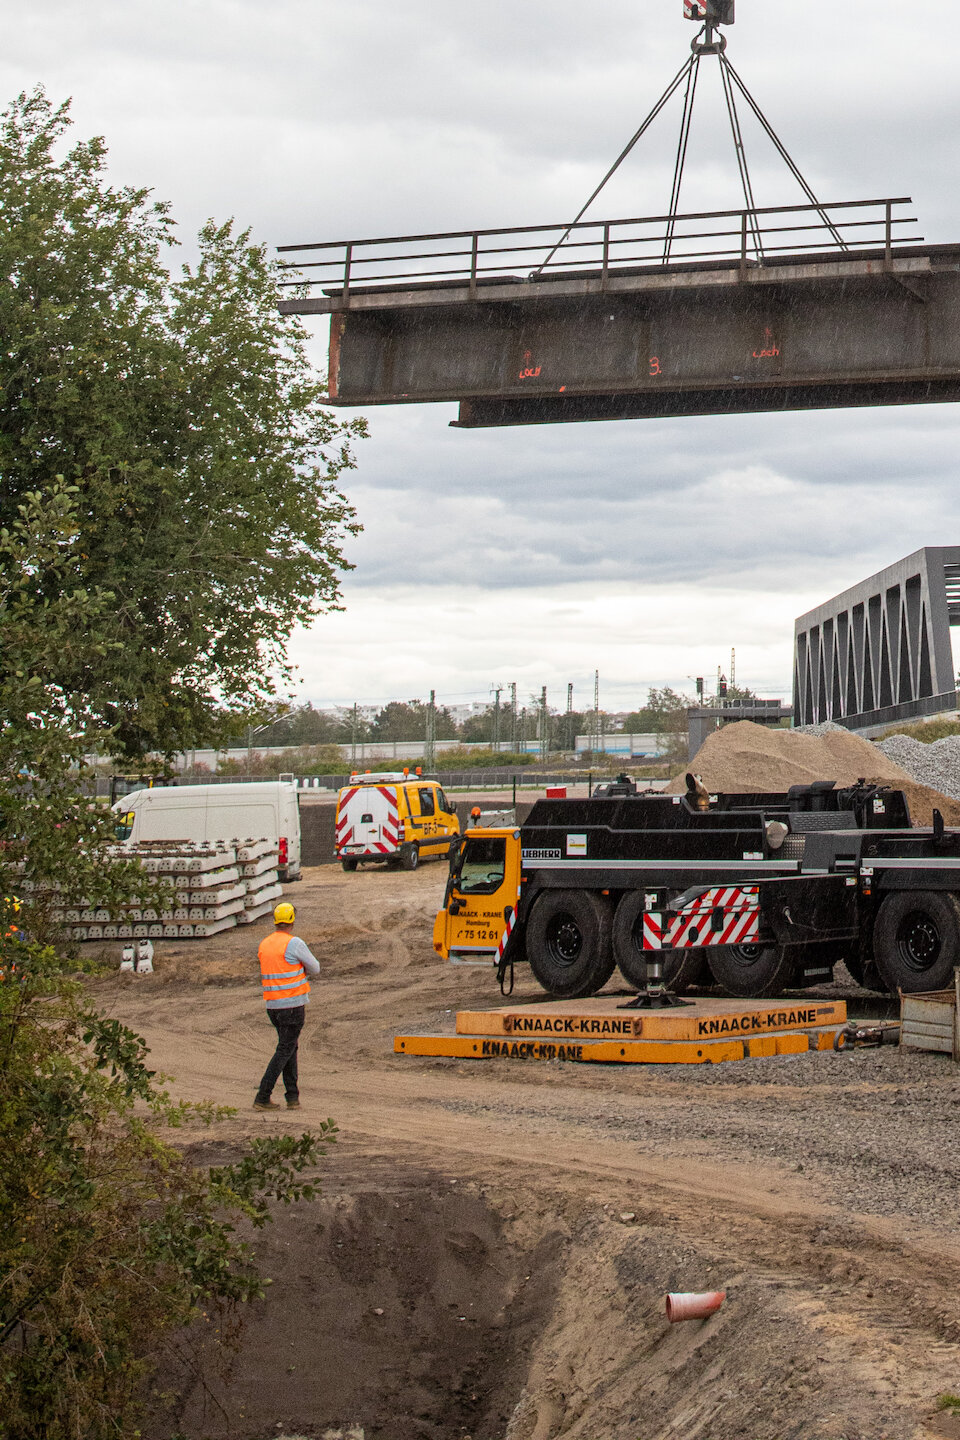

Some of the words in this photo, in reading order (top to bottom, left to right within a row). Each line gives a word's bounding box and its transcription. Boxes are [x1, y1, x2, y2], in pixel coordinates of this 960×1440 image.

[522, 849, 561, 858] LIEBHERR
[464, 930, 475, 939] 75
[477, 930, 487, 939] 12
[489, 930, 498, 940] 61
[513, 1017, 632, 1034] KNAACK-KRANE
[698, 1009, 816, 1035] KNAACK-KRANE
[482, 1040, 583, 1059] KNAACK-KRANE
